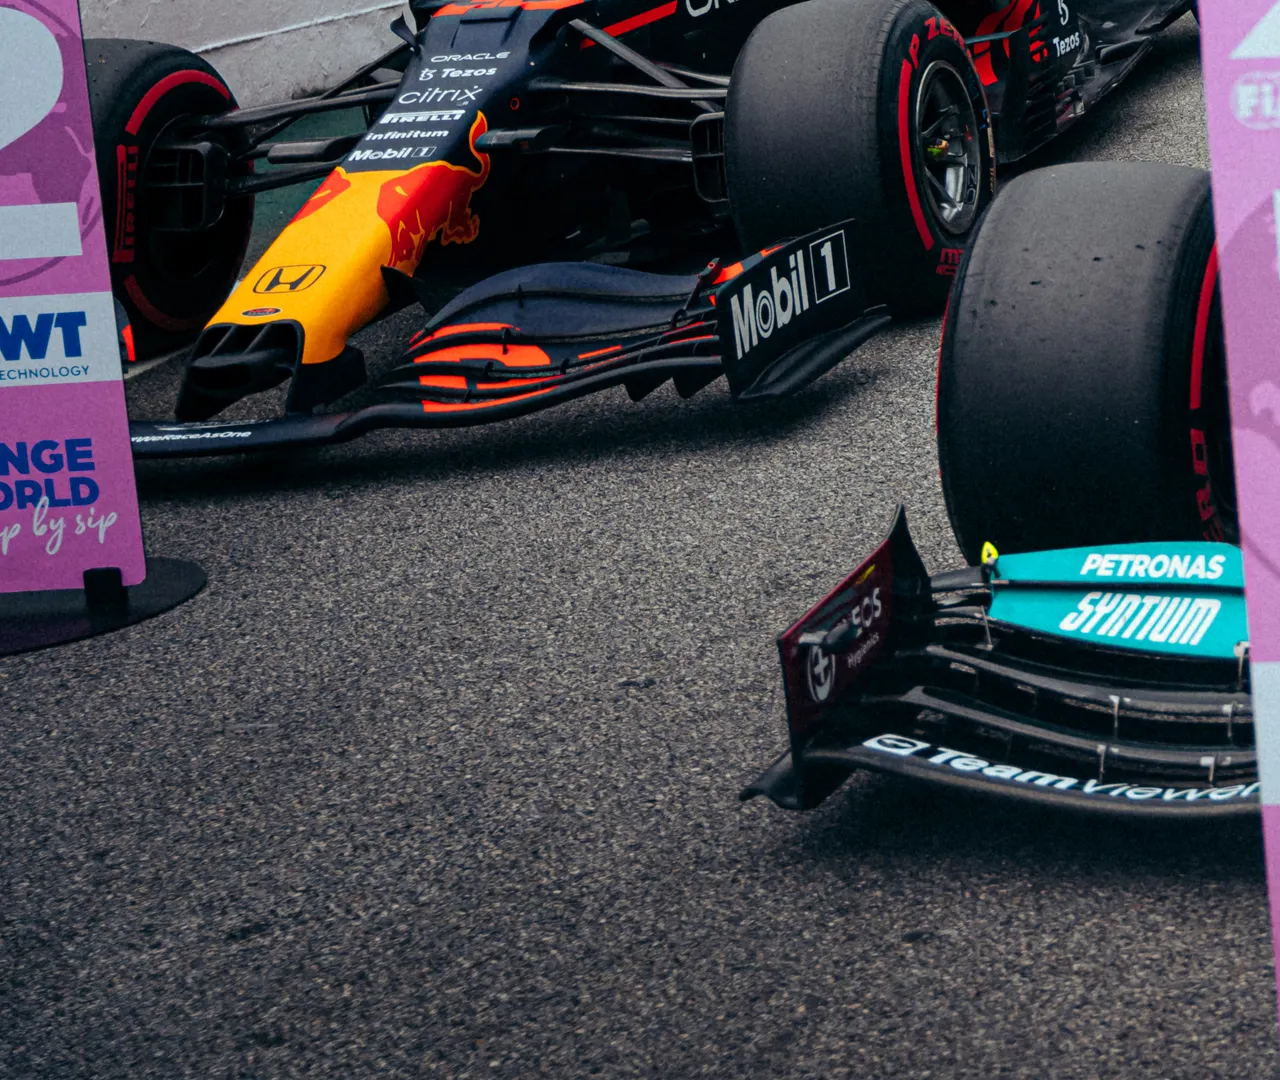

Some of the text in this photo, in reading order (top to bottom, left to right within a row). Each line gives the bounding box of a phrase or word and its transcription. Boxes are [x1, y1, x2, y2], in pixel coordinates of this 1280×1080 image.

[1052, 29, 1081, 59] Tezos
[430, 51, 512, 62] ORACLE
[442, 66, 497, 78] Tezos
[398, 85, 482, 105] citrix
[379, 110, 466, 125] PIRELLI
[365, 128, 449, 142] infinitum
[348, 146, 411, 161] Mobil
[730, 249, 810, 361] Mobil
[32, 496, 66, 555] by
[75, 506, 118, 544] sip
[1080, 553, 1227, 581] PETRONAS
[1059, 591, 1221, 647] SYNTIUM
